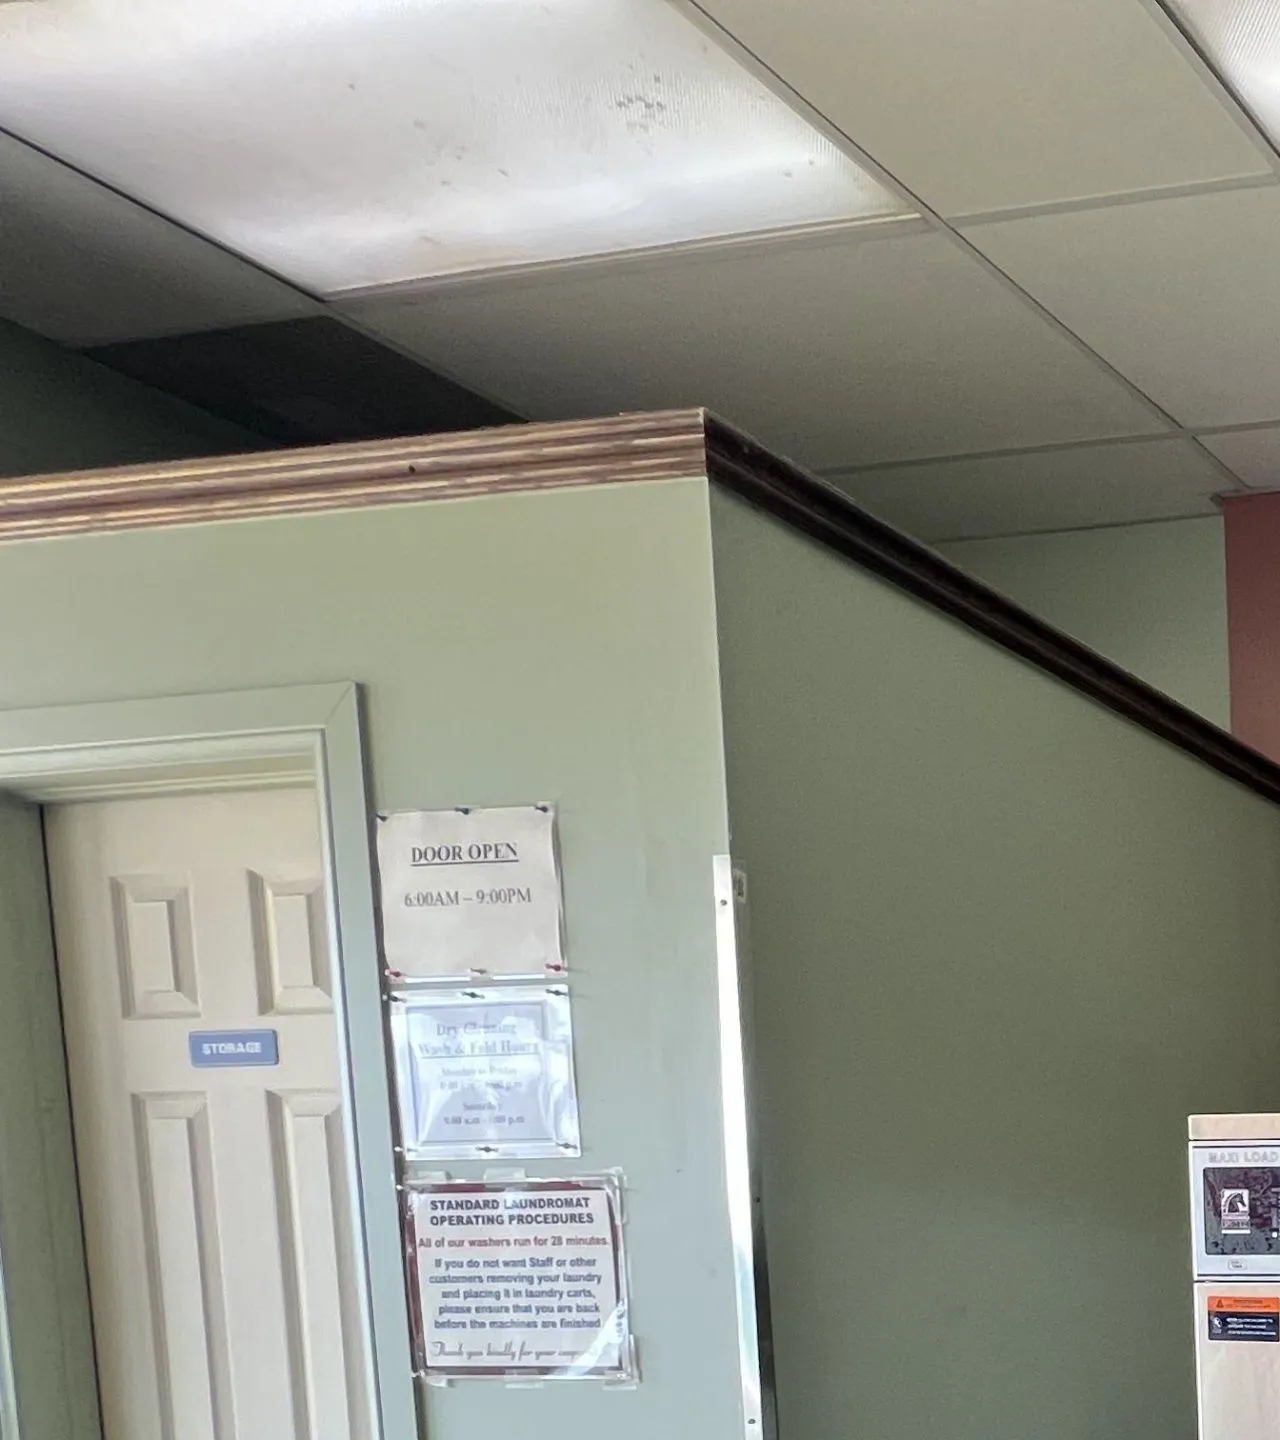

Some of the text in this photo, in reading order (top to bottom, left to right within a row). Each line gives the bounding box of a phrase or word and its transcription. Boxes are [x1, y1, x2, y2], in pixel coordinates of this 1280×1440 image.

[411, 843, 518, 863] DOOR OPEN
[404, 890, 460, 908] 6:00AM
[476, 888, 532, 905] 9:00PM
[202, 1042, 262, 1055] STORAGE
[1244, 1151, 1279, 1162] LOAD
[430, 1197, 590, 1211] STANDARD LAUNDROMAT
[430, 1212, 593, 1226] OPERATING PROCEDURES
[418, 1238, 432, 1248] All
[435, 1237, 445, 1248] of
[447, 1239, 465, 1248] our
[468, 1236, 511, 1247] washers
[514, 1238, 531, 1247] run
[534, 1236, 548, 1246] for
[551, 1236, 563, 1246] 28
[445, 1260, 464, 1271] you
[467, 1258, 480, 1268] do
[483, 1258, 500, 1268] not
[502, 1258, 526, 1268] want
[529, 1256, 554, 1267] Staff
[556, 1259, 567, 1267] or
[569, 1257, 597, 1267] other
[428, 1272, 602, 1285] customers removing your laundry
[441, 1289, 460, 1299] and
[463, 1289, 501, 1301] placing
[504, 1289, 511, 1298] it
[513, 1289, 523, 1298] in
[525, 1288, 563, 1300] laundry
[438, 1303, 600, 1316] please ensure that you are back
[434, 1319, 467, 1329] before
[469, 1319, 487, 1329] the
[489, 1318, 538, 1329] machines
[541, 1320, 557, 1329] are
